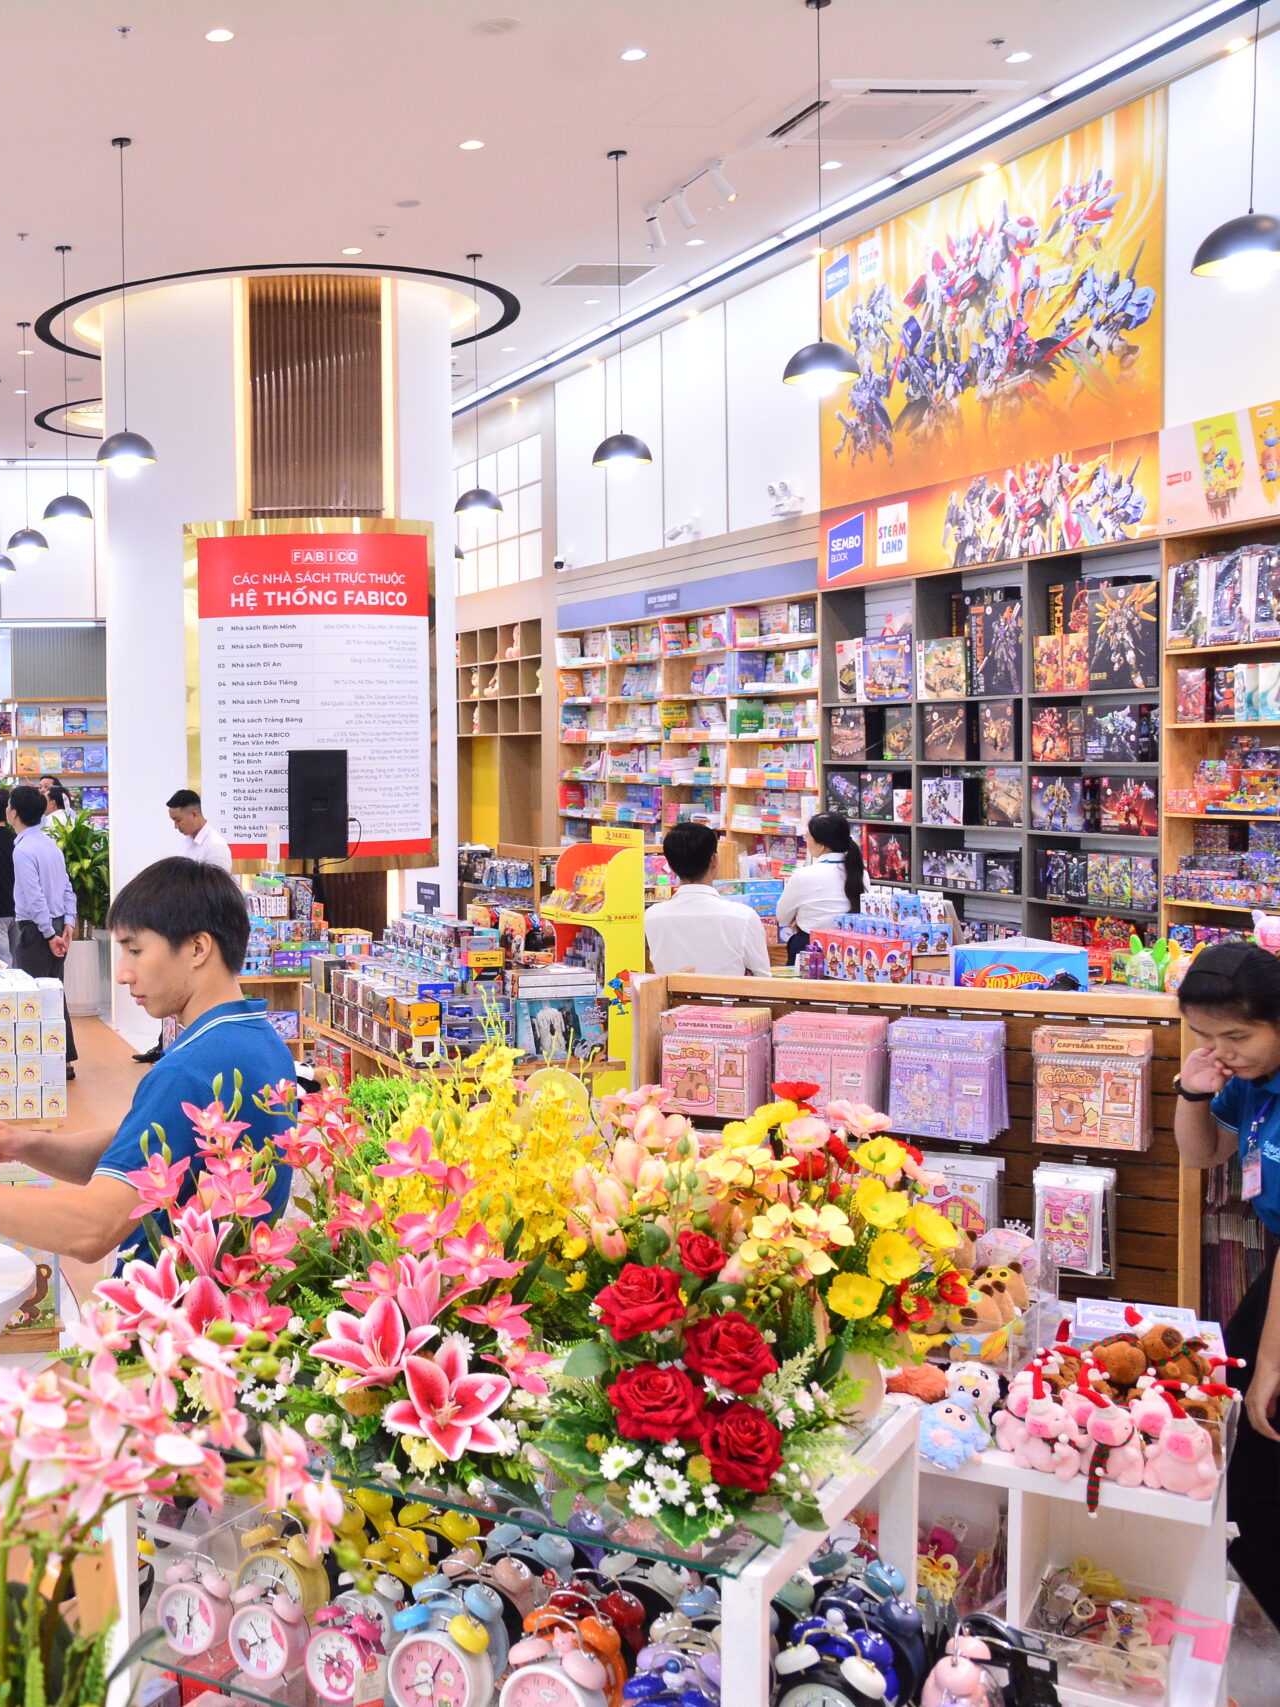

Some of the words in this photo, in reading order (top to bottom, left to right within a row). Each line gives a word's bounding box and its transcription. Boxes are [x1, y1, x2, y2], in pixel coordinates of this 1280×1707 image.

[878, 522, 906, 540] STEAM
[831, 535, 860, 552] SEMBO
[882, 539, 903, 554] LAND
[293, 552, 358, 562] FABICO
[831, 552, 848, 563] BLOCK
[233, 572, 260, 586] CÁC
[263, 571, 292, 584] NHÀ
[295, 571, 330, 584] SÁCH
[334, 573, 366, 586] TRỰC
[370, 571, 406, 586] THUỘC
[231, 589, 258, 610] HỆ
[264, 586, 338, 606] THỐNG
[344, 591, 408, 607] FABICO
[1054, 592, 1064, 636] ECHA
[800, 618, 812, 629] SAT
[612, 832, 631, 840] PANINI
